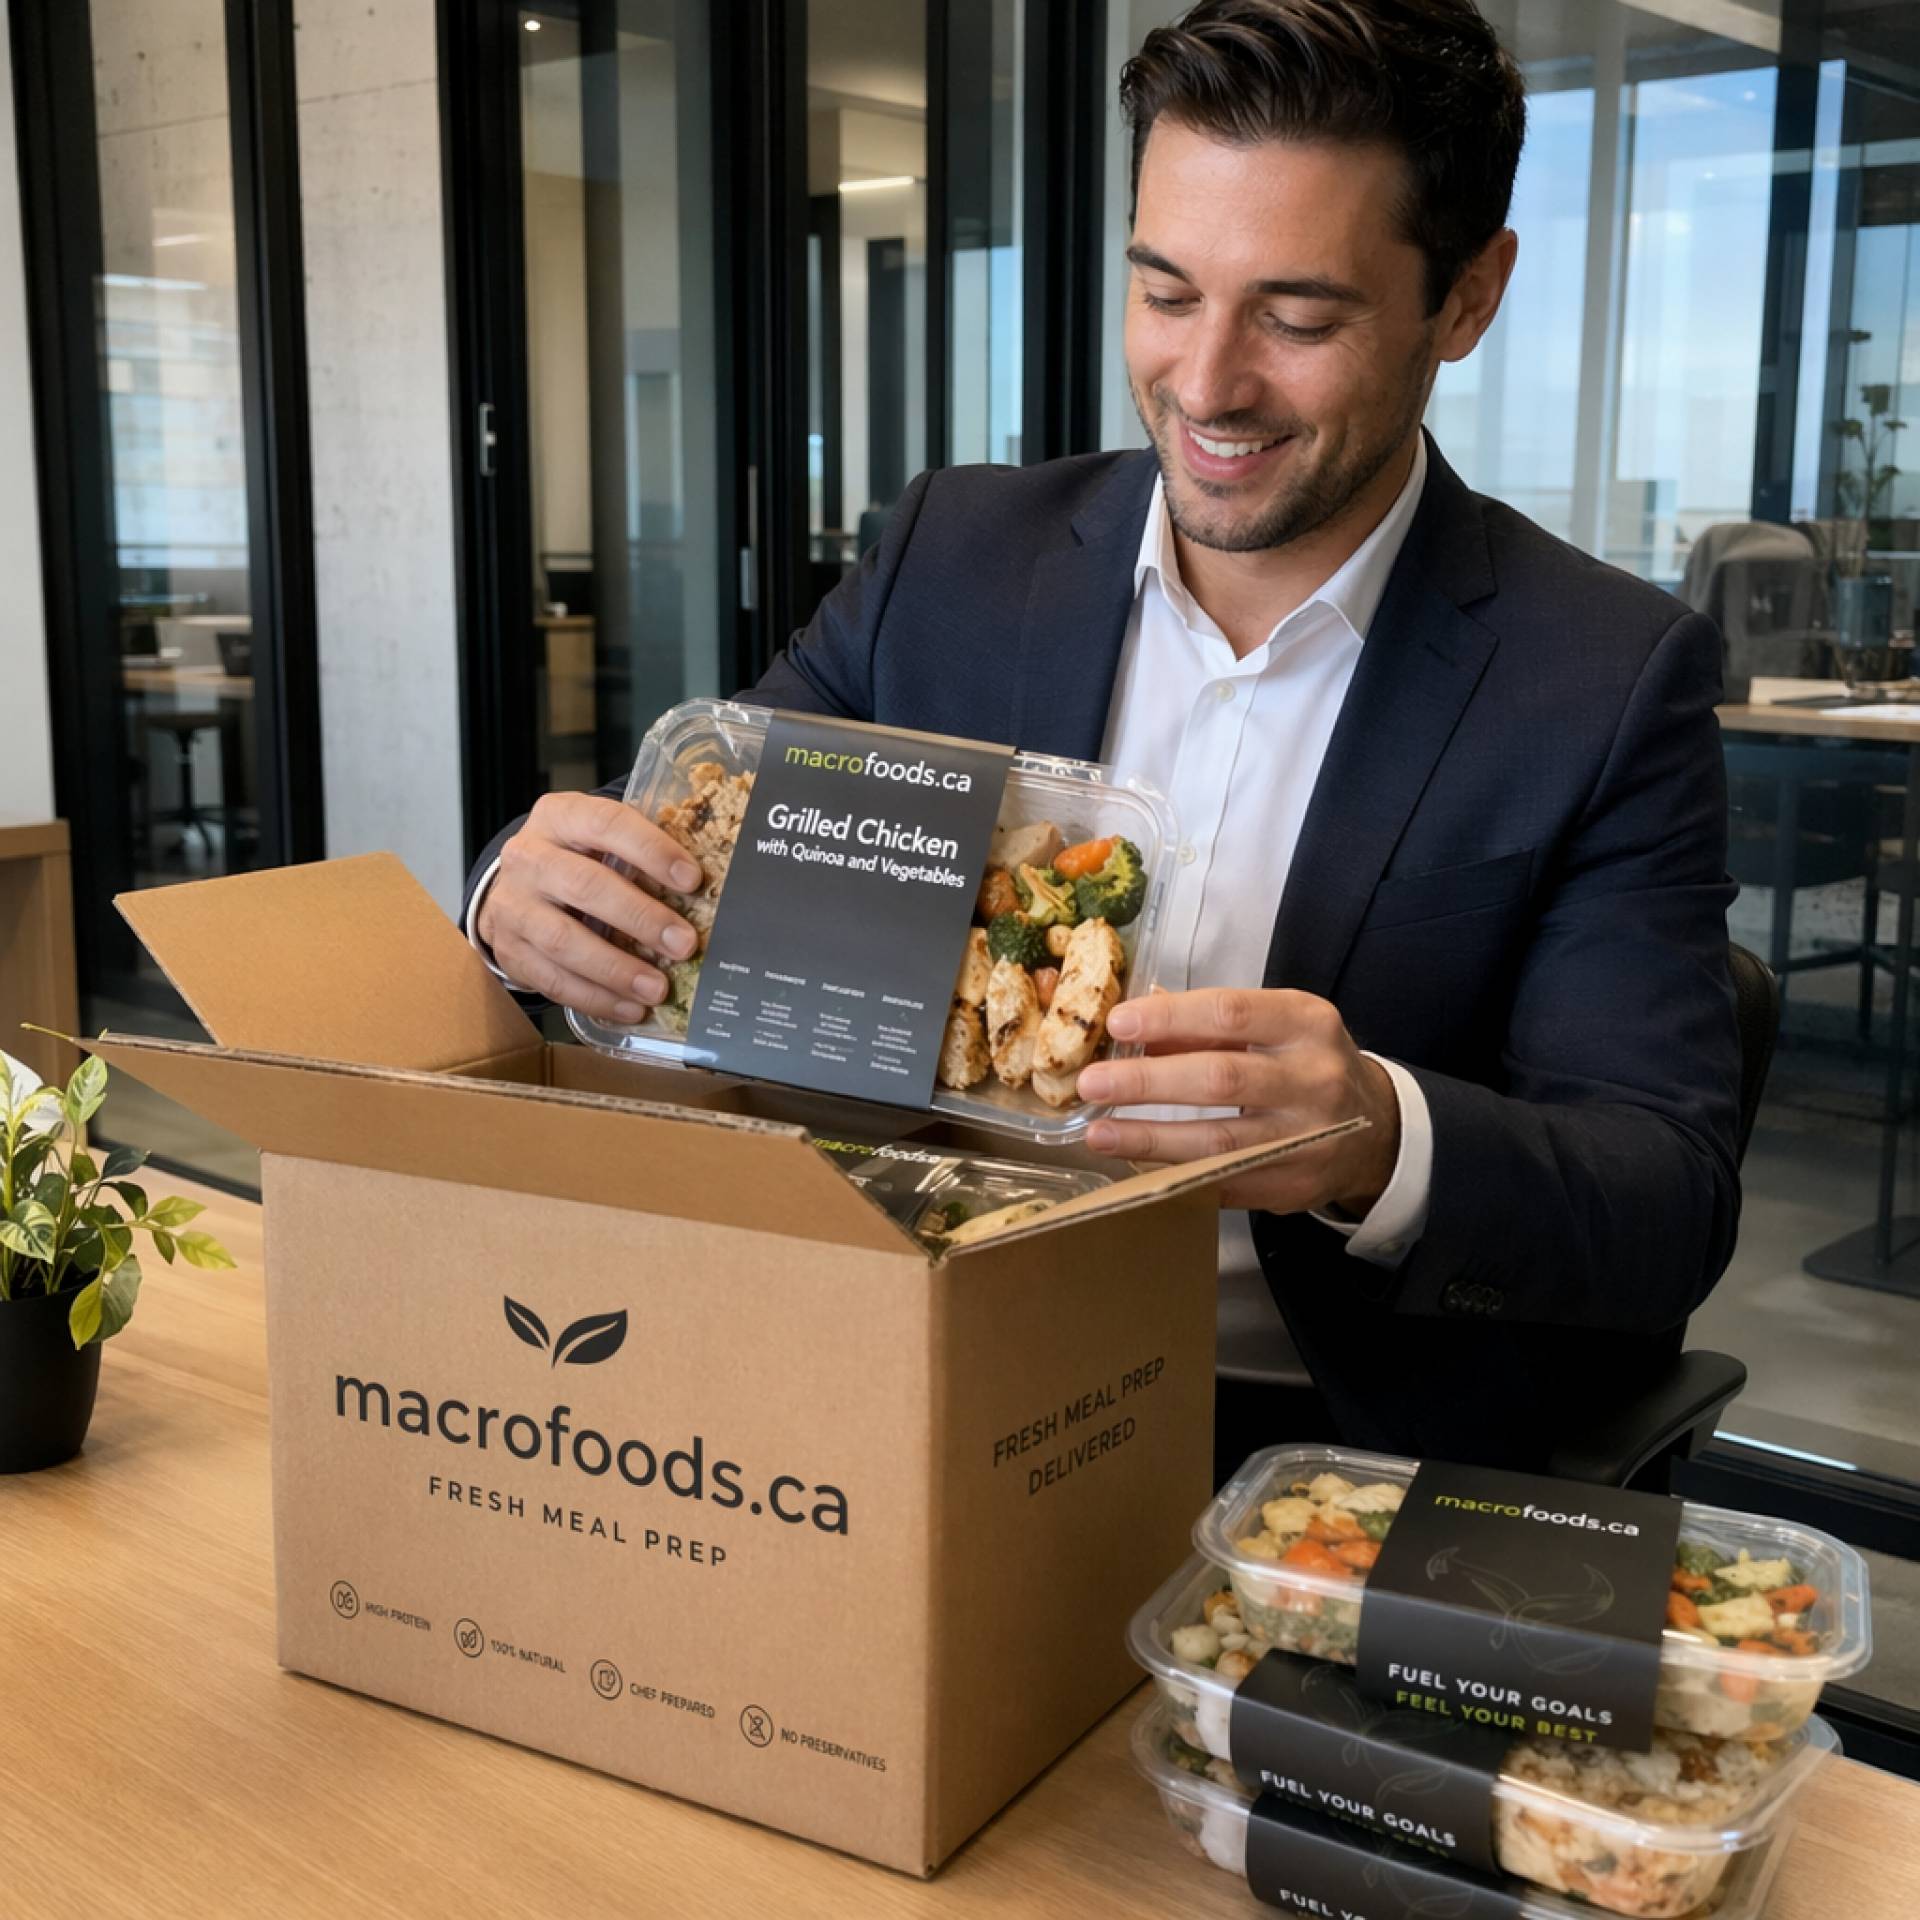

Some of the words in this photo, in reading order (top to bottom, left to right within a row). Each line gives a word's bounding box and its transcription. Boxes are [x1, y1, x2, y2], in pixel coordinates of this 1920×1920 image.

[785, 746, 972, 792] macrofoods.ca
[768, 804, 852, 840] Grilled
[857, 819, 958, 859] Chicken
[757, 838, 788, 856] with
[792, 843, 844, 867] Quinoa
[848, 855, 878, 872] and
[881, 857, 965, 888] Vegetables
[993, 1412, 1058, 1469] FRESH
[1065, 1384, 1117, 1430] MEAL
[1121, 1356, 1164, 1398] PREP
[336, 1375, 848, 1535] macrofoods.ca
[1029, 1417, 1136, 1496] DELIVERED
[429, 1475, 524, 1518] FRESH
[543, 1503, 627, 1544] MEAL
[644, 1529, 727, 1566] PREP
[1434, 1495, 1640, 1537] macrofoods.ca
[366, 1602, 388, 1619] HIGH
[391, 1609, 431, 1631] PROTEIN
[491, 1640, 516, 1658] 100%
[518, 1648, 566, 1674] NATURAL
[630, 1683, 656, 1700] CHEF
[661, 1691, 715, 1719] PREPARED
[1388, 1662, 1447, 1690] FUEL
[1456, 1678, 1521, 1707] YOUR
[1531, 1696, 1613, 1725] GOALS
[1396, 1690, 1451, 1715] FEEL
[1460, 1704, 1526, 1730] YOUR
[1536, 1720, 1598, 1744] BEST
[781, 1728, 798, 1744] NO
[800, 1735, 887, 1772] PRESERVATIVES
[1260, 1769, 1312, 1798] FUEL
[1317, 1789, 1376, 1820] YOUR
[1383, 1812, 1457, 1848] GOALS
[1279, 1888, 1335, 1917] FUEL
